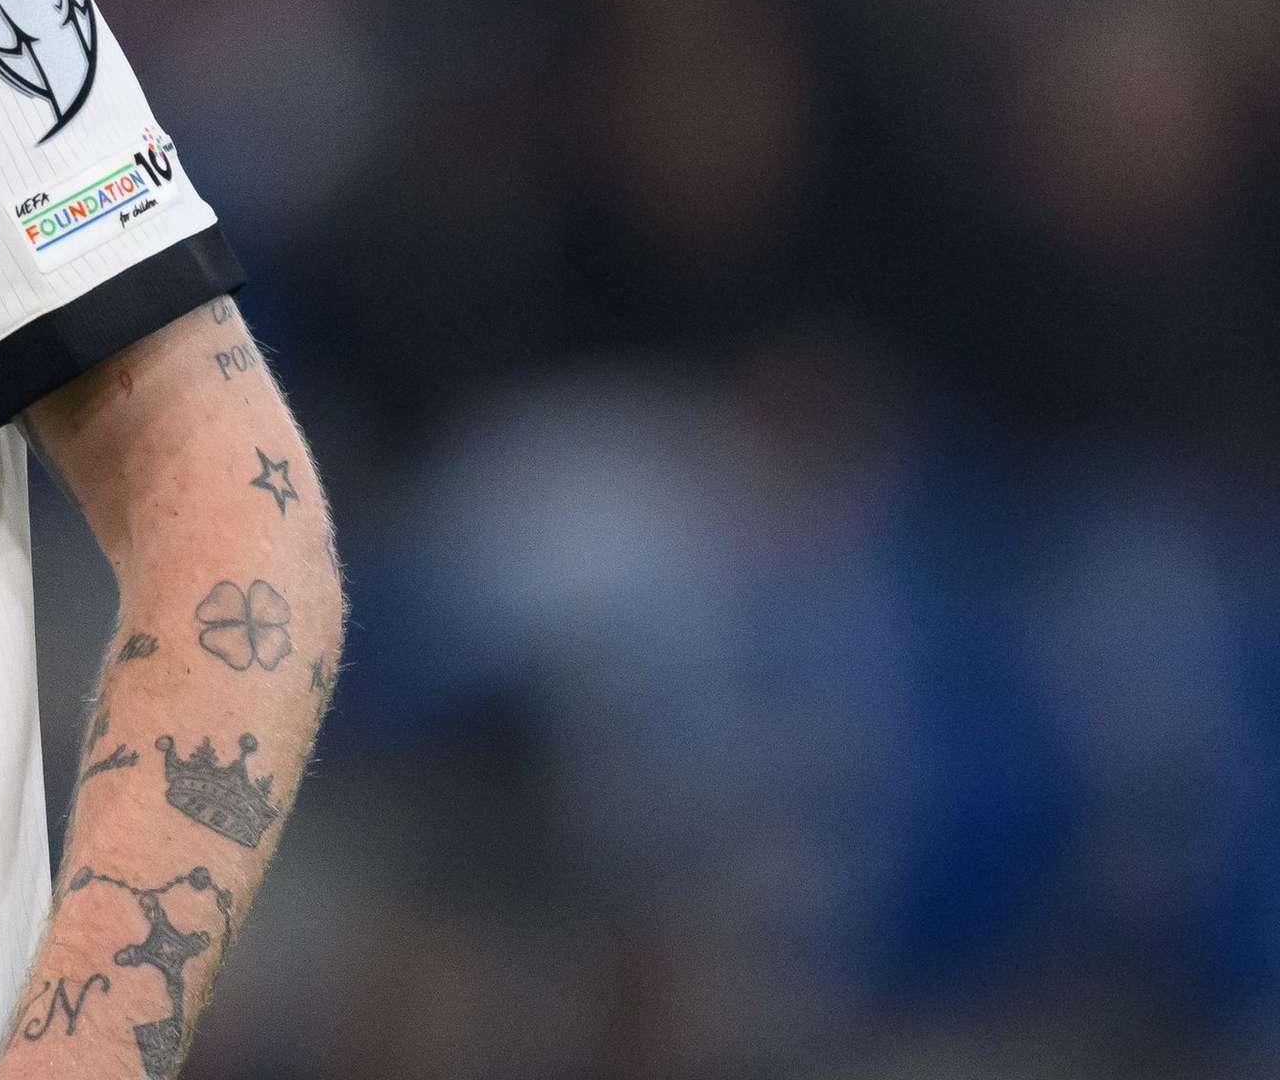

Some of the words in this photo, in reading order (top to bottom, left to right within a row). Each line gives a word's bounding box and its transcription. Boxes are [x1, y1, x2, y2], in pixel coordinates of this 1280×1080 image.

[16, 193, 50, 218] UEFA
[26, 170, 144, 244] FOUNDATION
[119, 211, 131, 229] for
[132, 199, 158, 217] children
